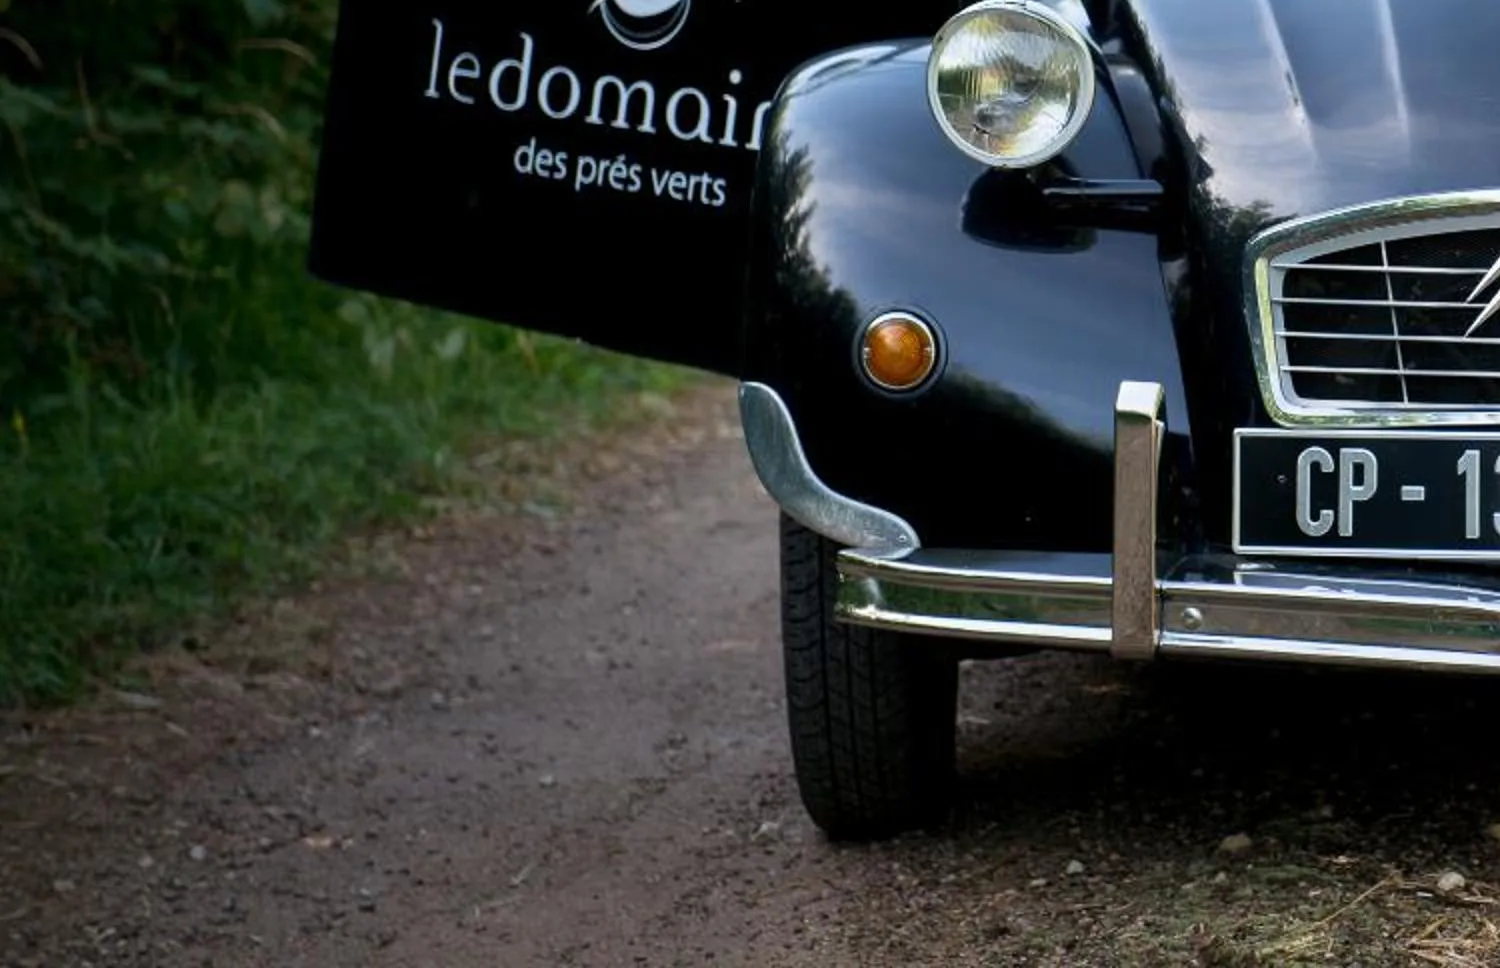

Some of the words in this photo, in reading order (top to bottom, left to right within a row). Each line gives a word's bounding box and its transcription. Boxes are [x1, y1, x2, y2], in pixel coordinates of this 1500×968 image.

[513, 136, 567, 180] des
[574, 153, 642, 192] prés
[651, 167, 727, 207] verts
